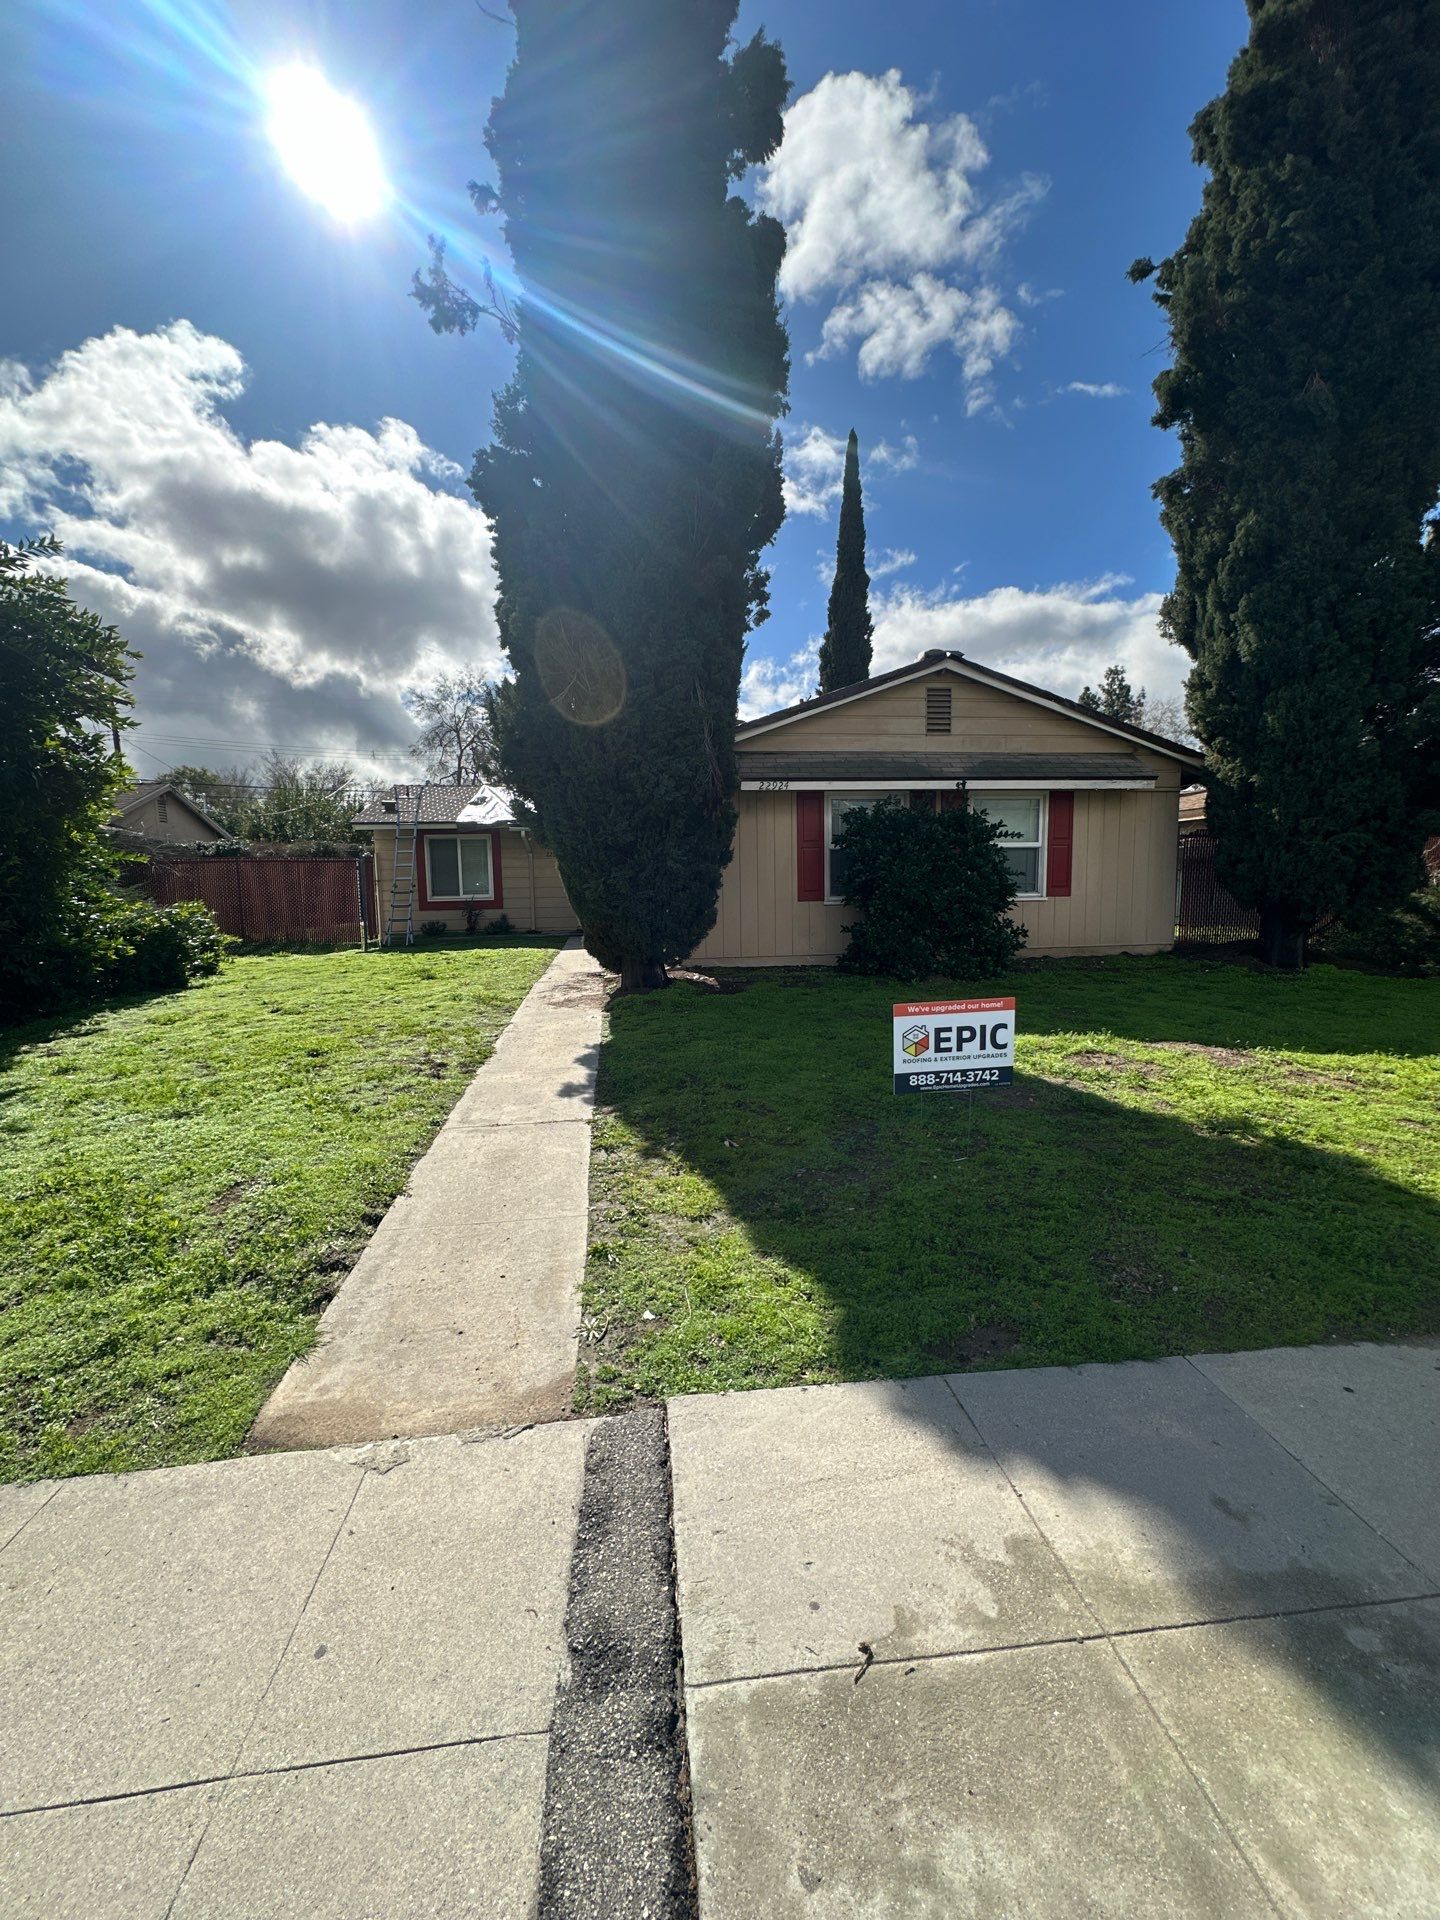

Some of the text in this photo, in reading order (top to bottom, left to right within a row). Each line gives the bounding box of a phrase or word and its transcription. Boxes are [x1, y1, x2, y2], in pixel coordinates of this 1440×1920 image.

[907, 1005, 929, 1013] We've
[931, 1003, 966, 1013] upgraded
[981, 1001, 1003, 1009] home!
[934, 1023, 1008, 1053] EPIC
[973, 1052, 1007, 1060] UPGRADES
[909, 1069, 999, 1086] 888-714-3742
